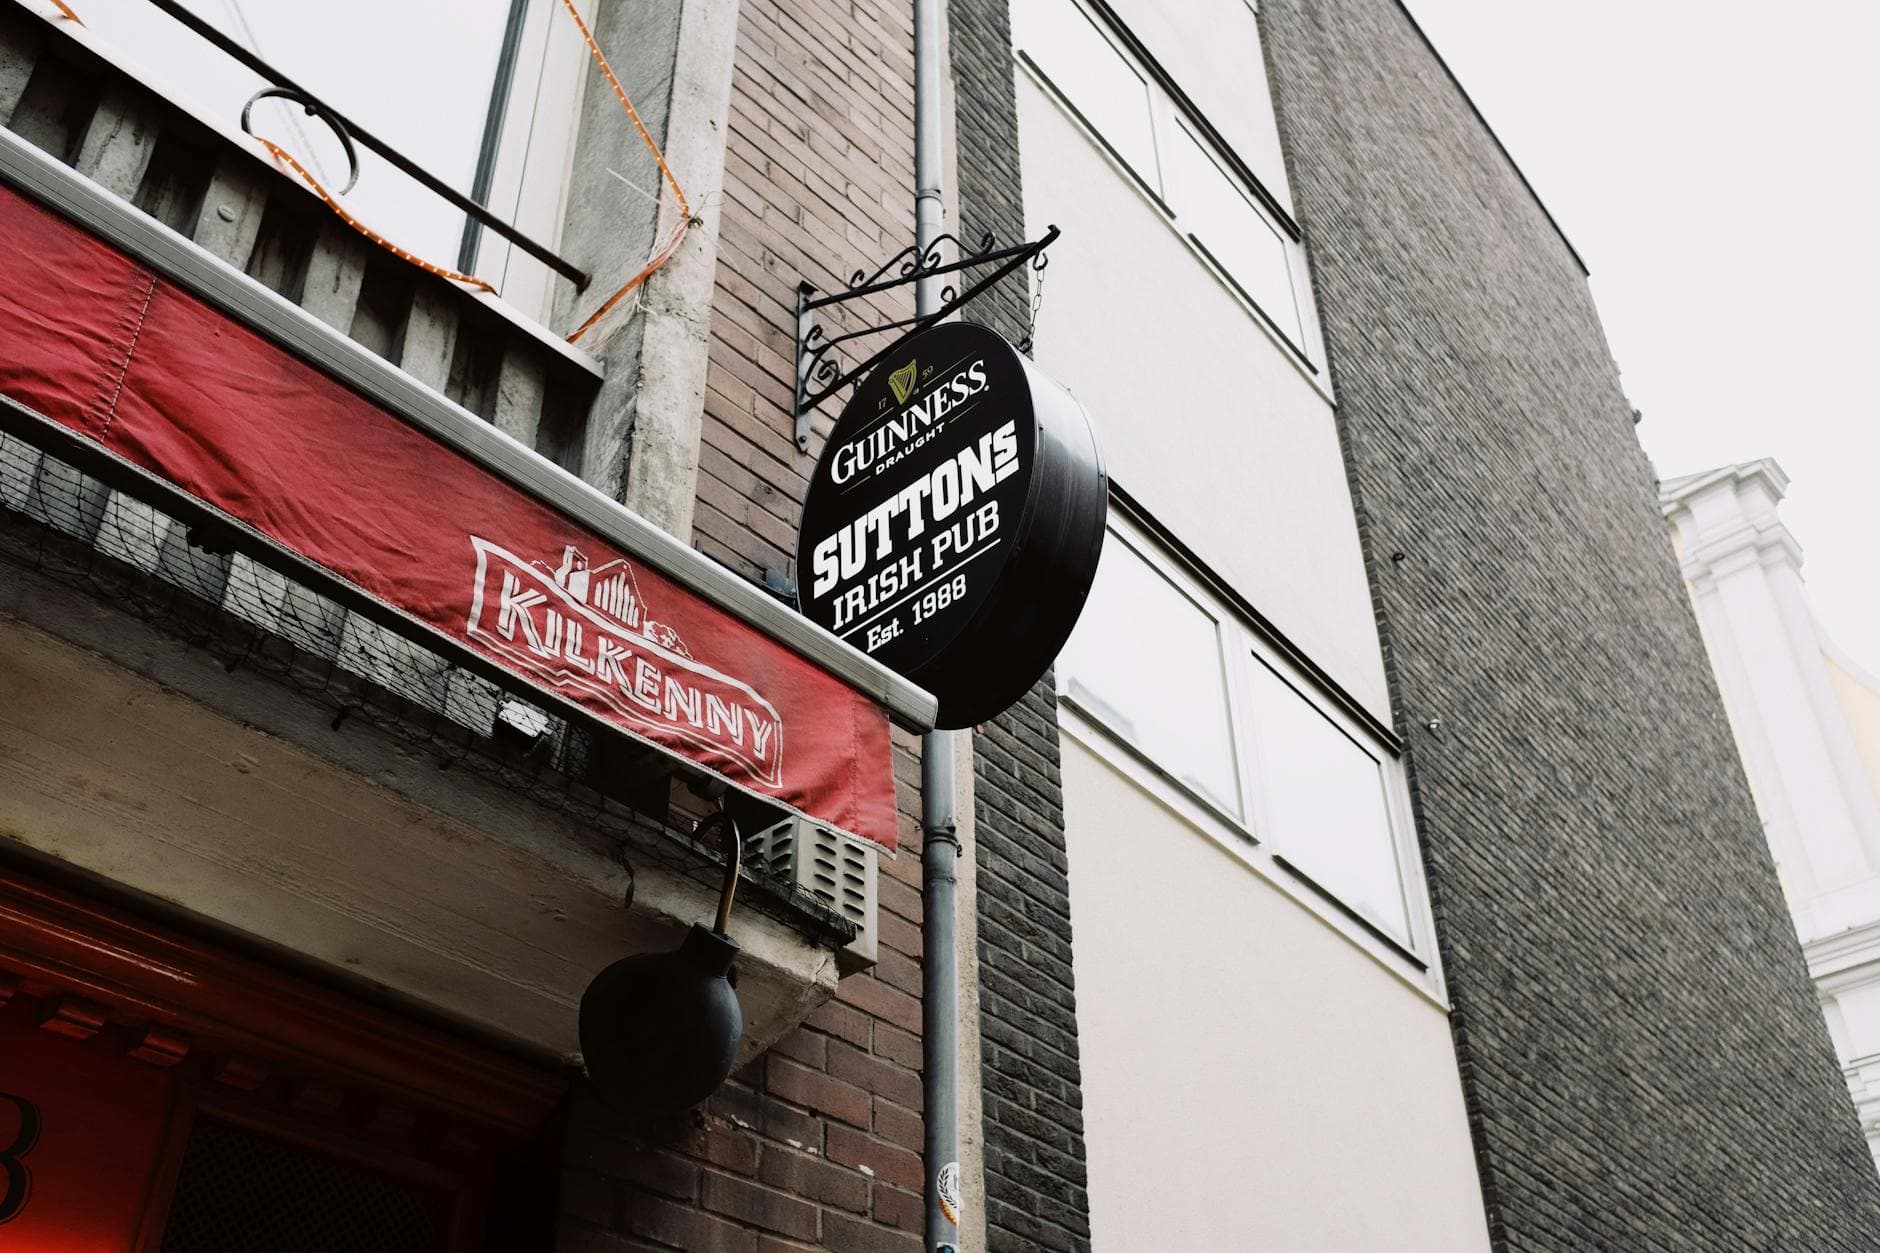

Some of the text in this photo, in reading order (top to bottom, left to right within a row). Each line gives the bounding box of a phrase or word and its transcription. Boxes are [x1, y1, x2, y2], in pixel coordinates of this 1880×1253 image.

[812, 418, 1020, 600] SUTTONS
[874, 420, 946, 476] DRAUGHT
[832, 499, 1000, 631] IRISH PUB
[866, 573, 967, 653] Est. 1988
[496, 569, 773, 761] KILKENNY
